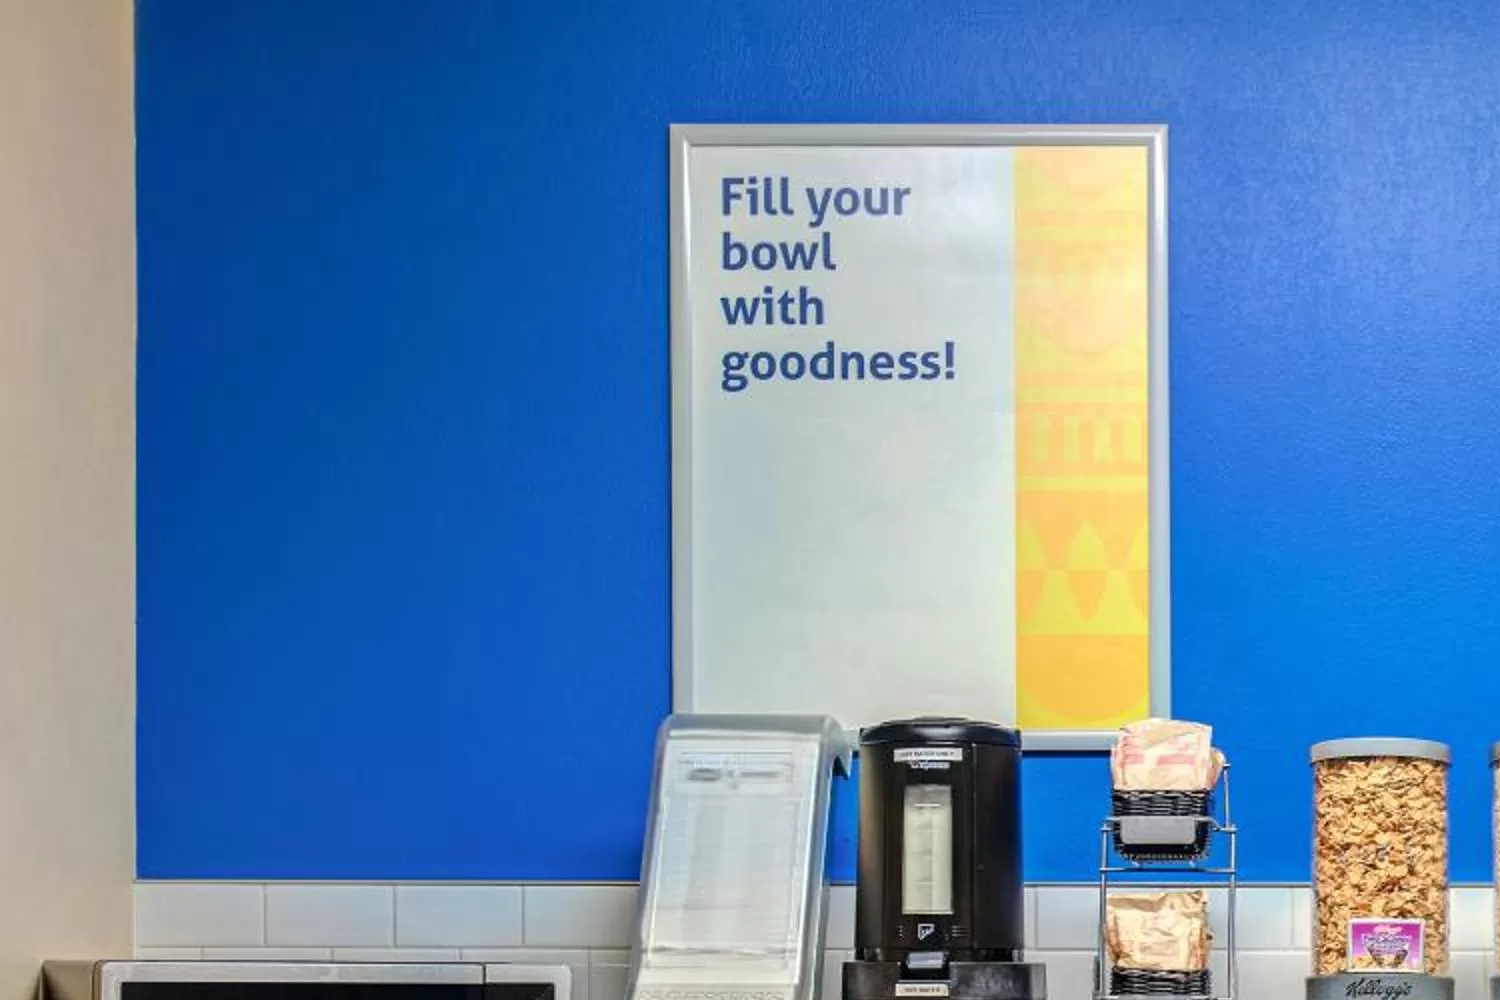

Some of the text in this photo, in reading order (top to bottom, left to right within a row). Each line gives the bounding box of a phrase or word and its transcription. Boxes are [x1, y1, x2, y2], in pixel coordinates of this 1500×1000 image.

[721, 176, 912, 228] Fill your
[721, 232, 837, 271] bowl
[720, 286, 825, 325] with
[720, 340, 956, 392] goodness!
